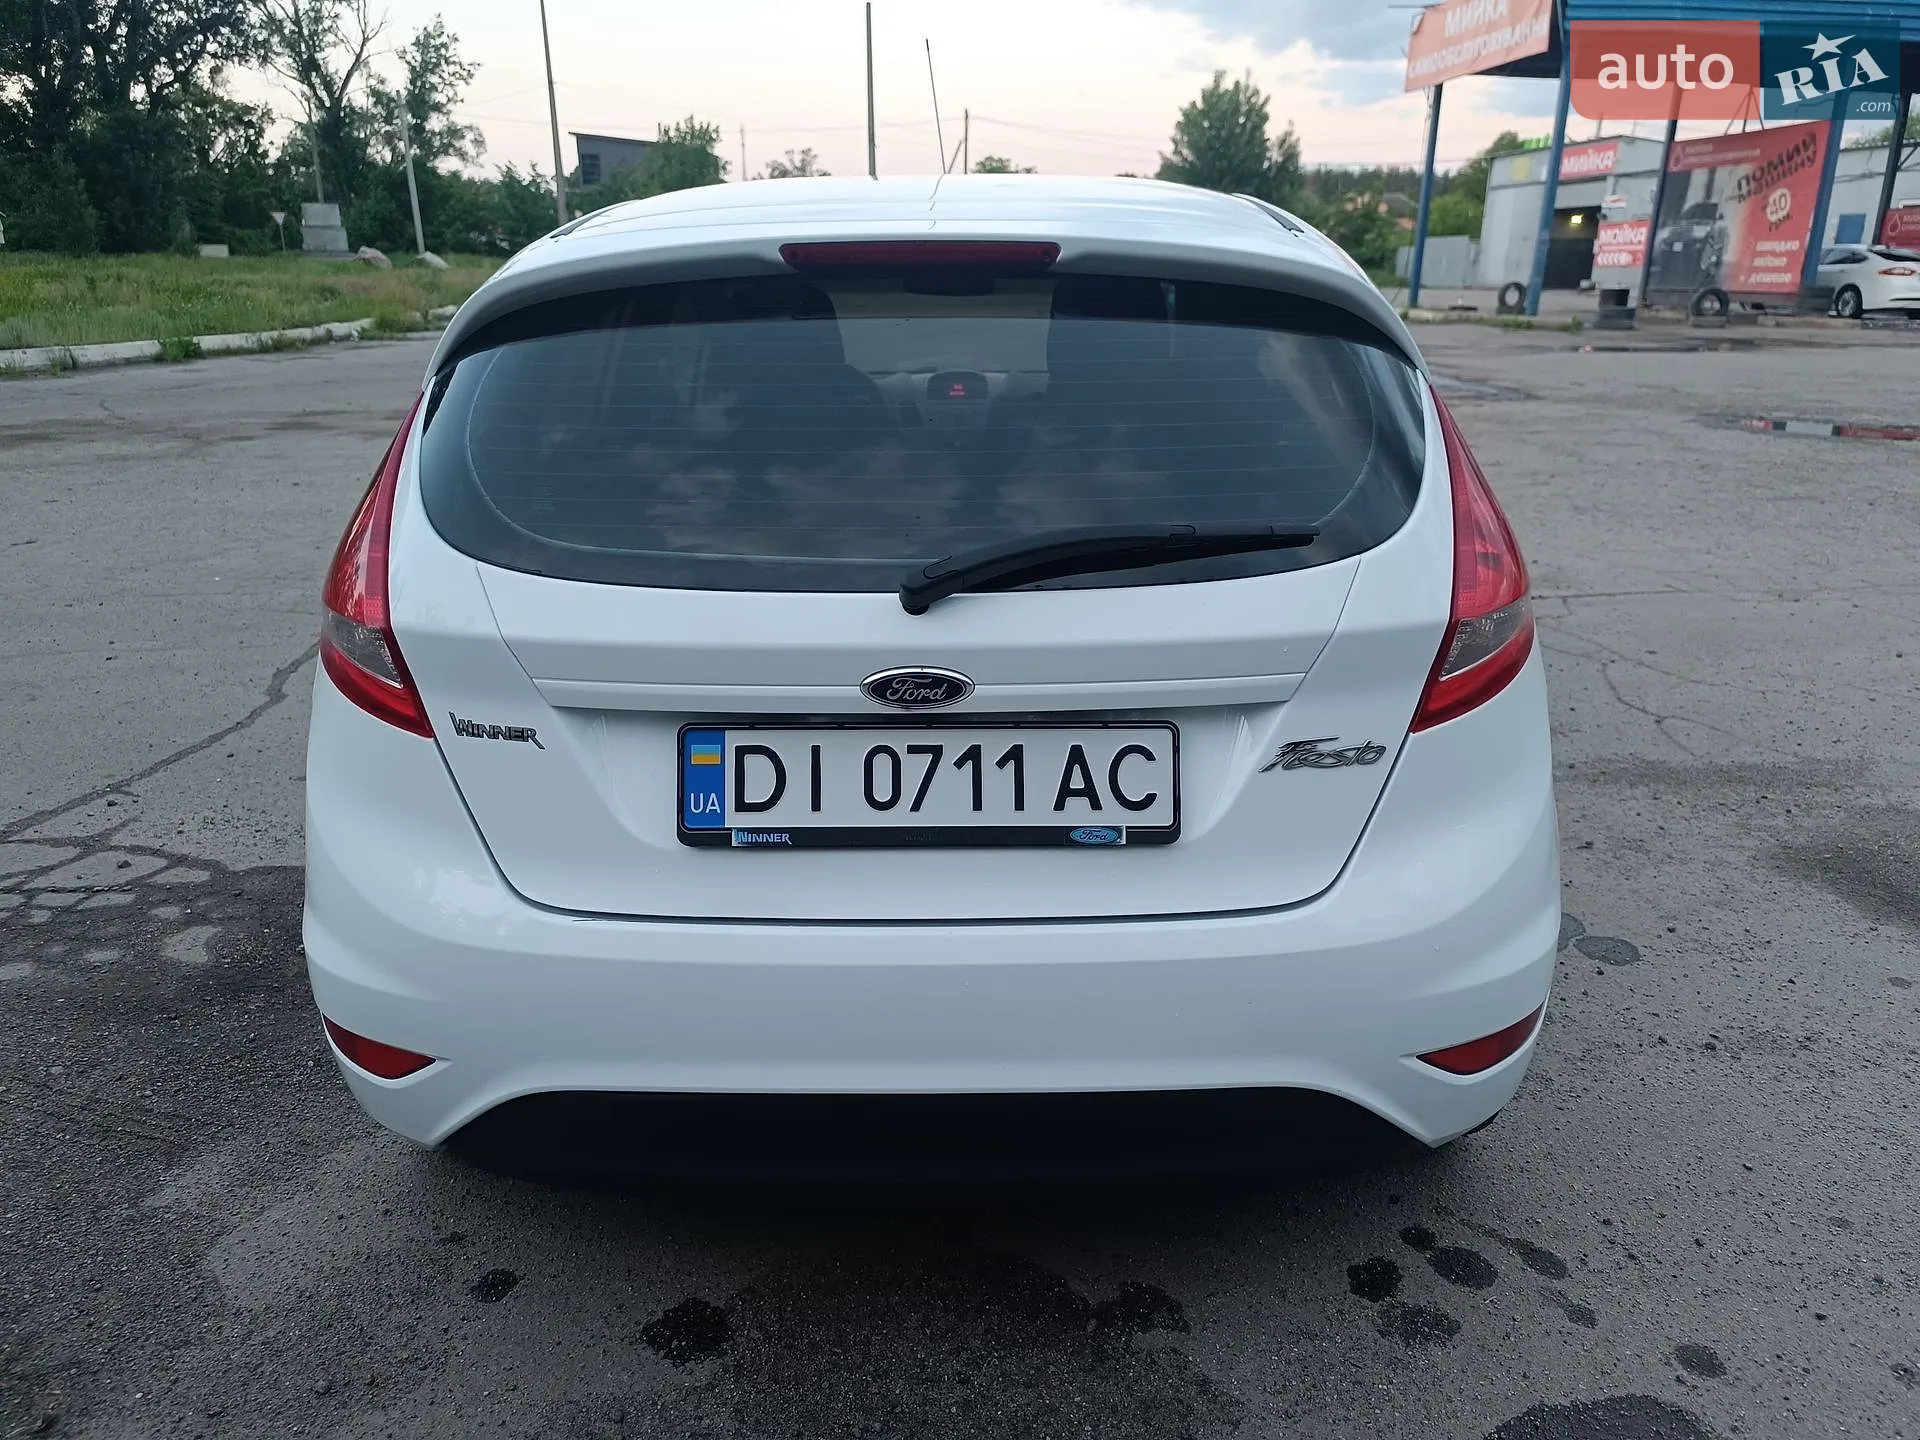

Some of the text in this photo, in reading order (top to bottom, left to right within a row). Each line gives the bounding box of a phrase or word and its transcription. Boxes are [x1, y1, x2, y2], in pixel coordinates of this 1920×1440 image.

[886, 677, 948, 701] Ford
[448, 711, 546, 750] WINNER
[1257, 735, 1387, 773] Fiesta
[734, 743, 1159, 814] DI 0711 AC
[690, 792, 721, 814] UA
